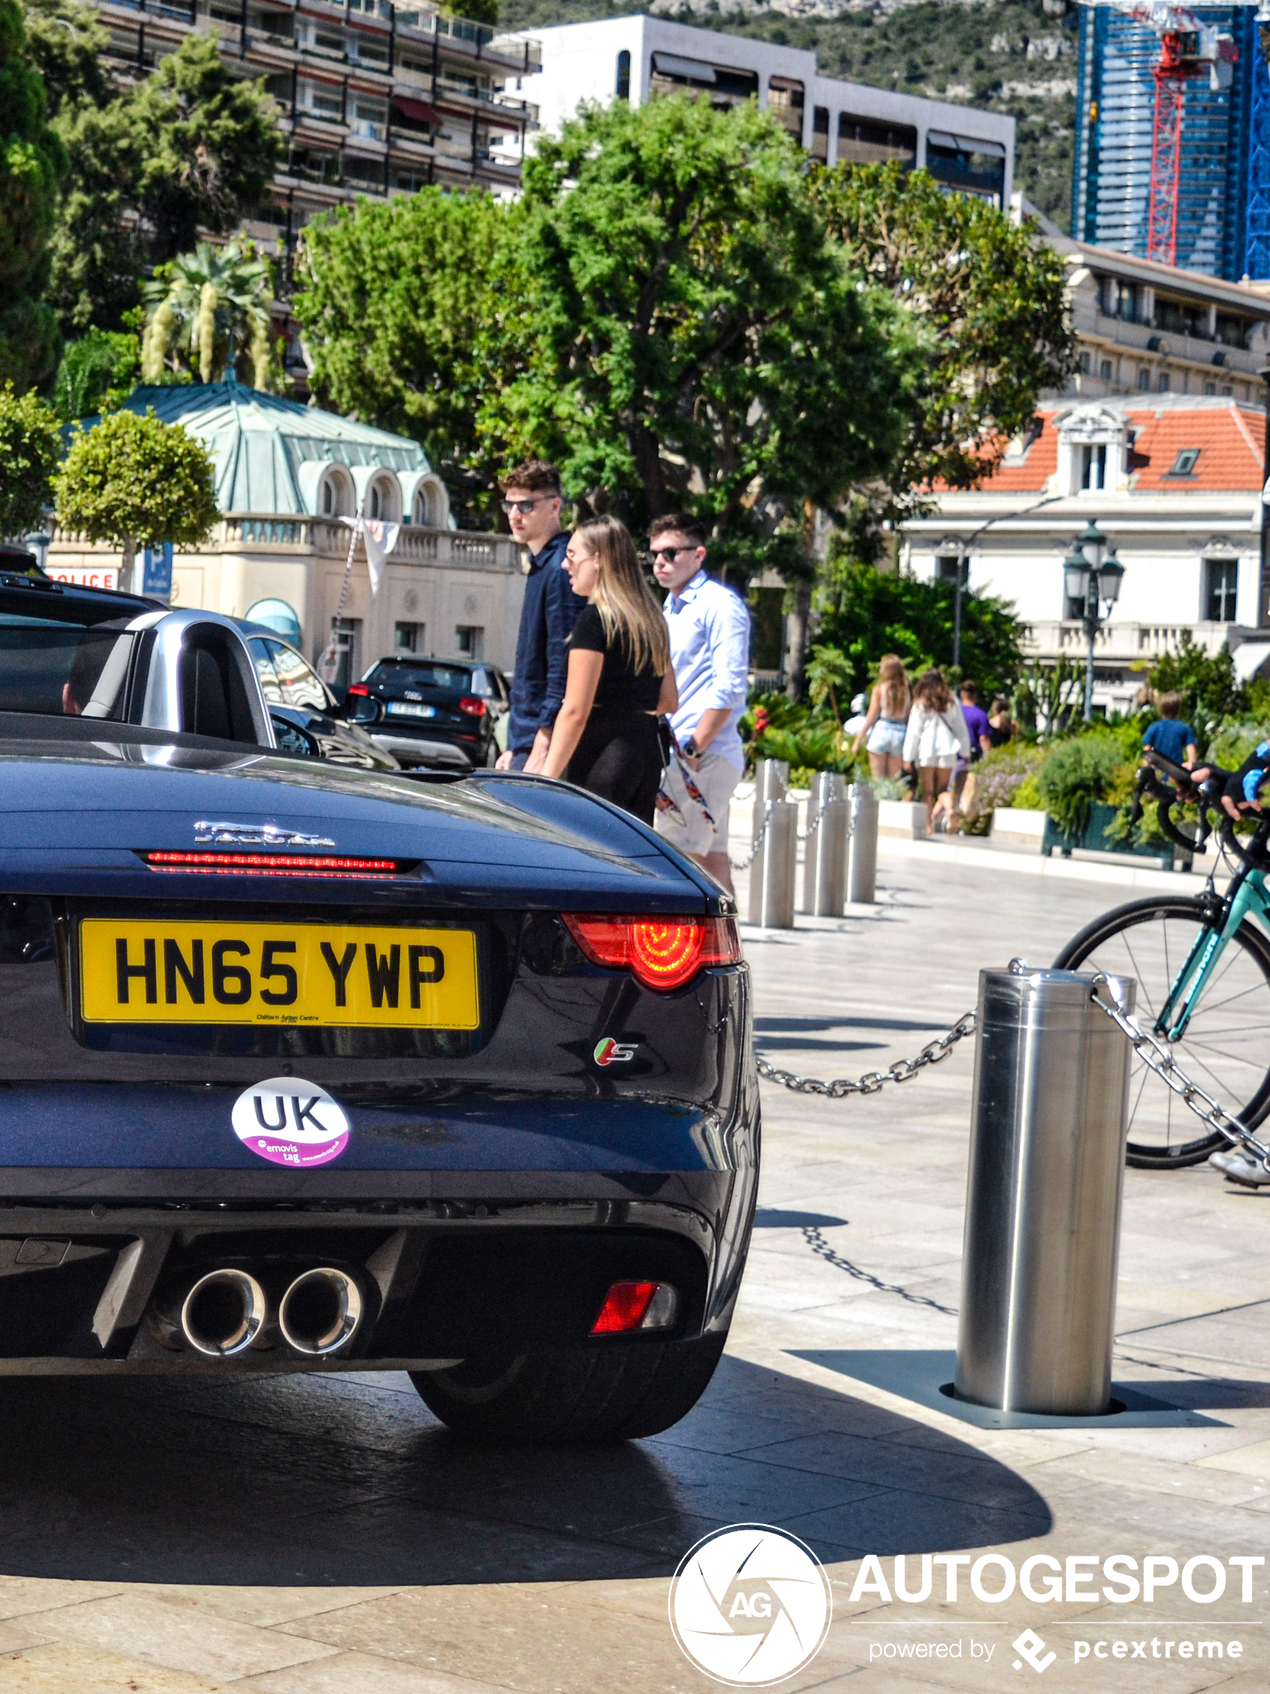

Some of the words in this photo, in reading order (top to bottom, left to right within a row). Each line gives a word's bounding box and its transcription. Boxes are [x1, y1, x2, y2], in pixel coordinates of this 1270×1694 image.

[115, 938, 298, 1006] HN65
[320, 942, 445, 1009] YWP
[253, 1095, 328, 1131] UK
[266, 1143, 298, 1153] emovis
[283, 1152, 301, 1164] tag
